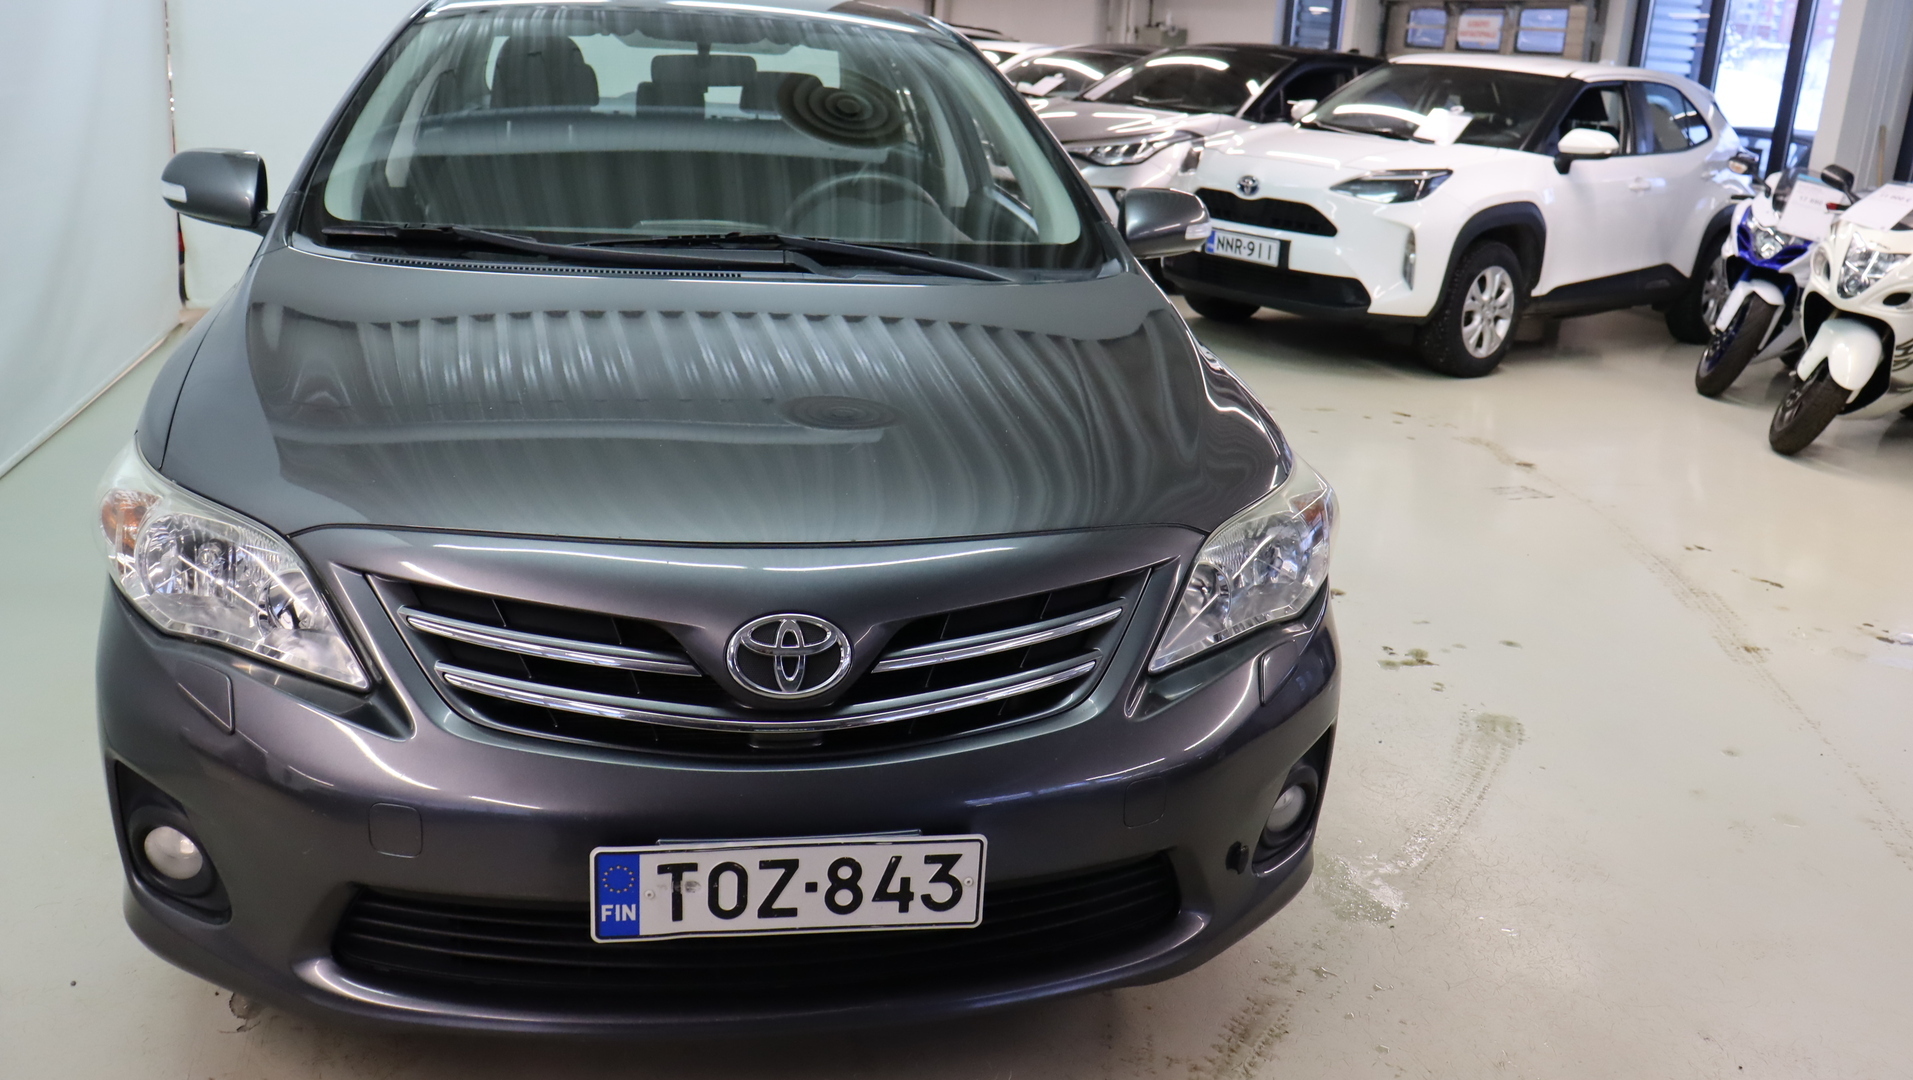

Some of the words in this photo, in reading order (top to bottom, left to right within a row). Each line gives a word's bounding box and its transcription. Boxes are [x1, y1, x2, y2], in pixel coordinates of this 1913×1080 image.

[1216, 236, 1271, 260] NNR-911
[657, 854, 963, 922] TOZ-843
[601, 904, 636, 922] FIN
